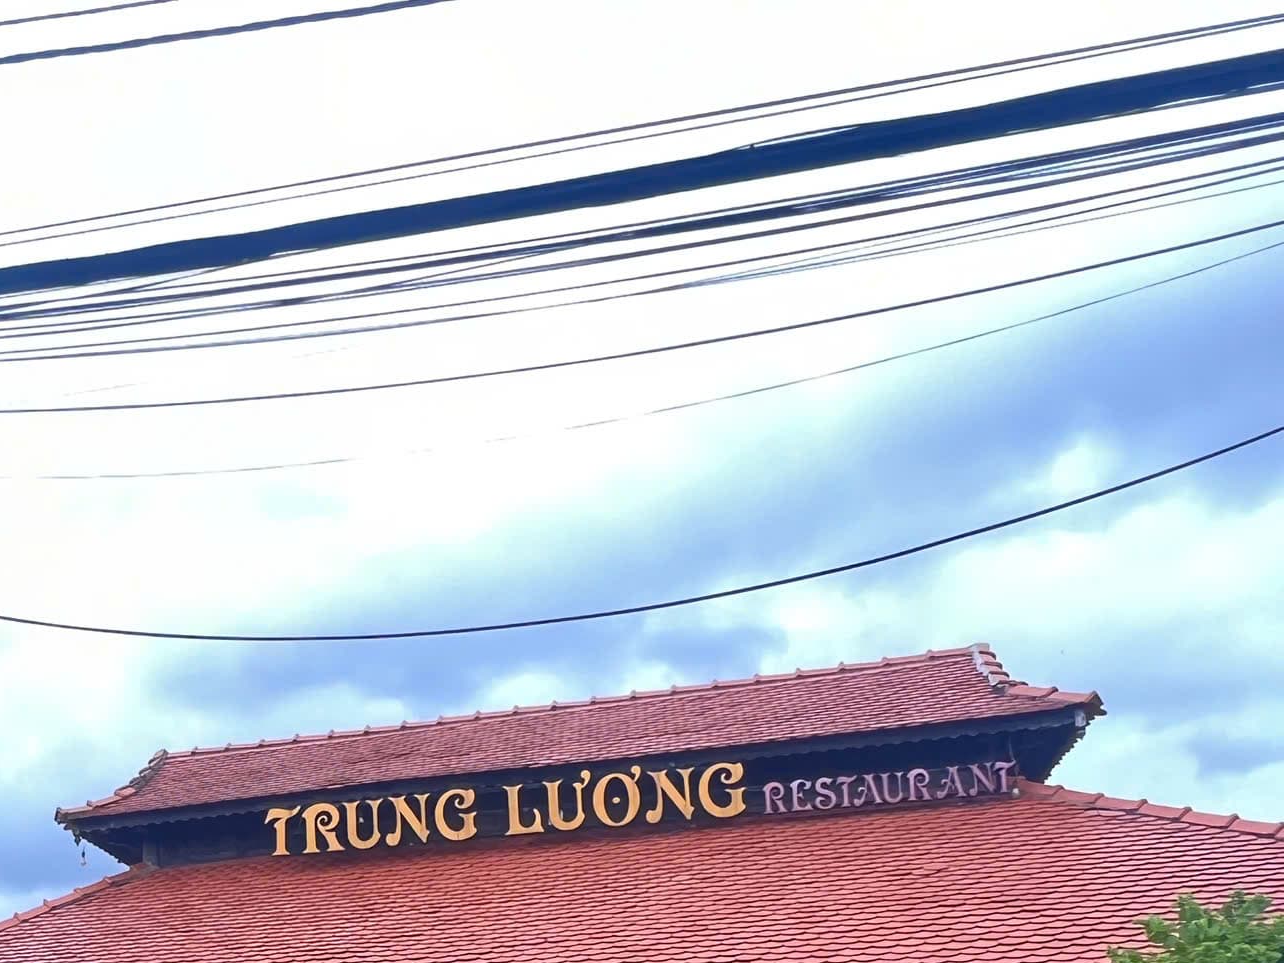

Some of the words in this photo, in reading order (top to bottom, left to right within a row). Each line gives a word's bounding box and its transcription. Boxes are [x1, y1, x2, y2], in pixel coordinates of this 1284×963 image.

[264, 788, 478, 856] TRUNG
[502, 762, 747, 836] LƯƠNG
[762, 760, 1016, 815] RESTAURANT
